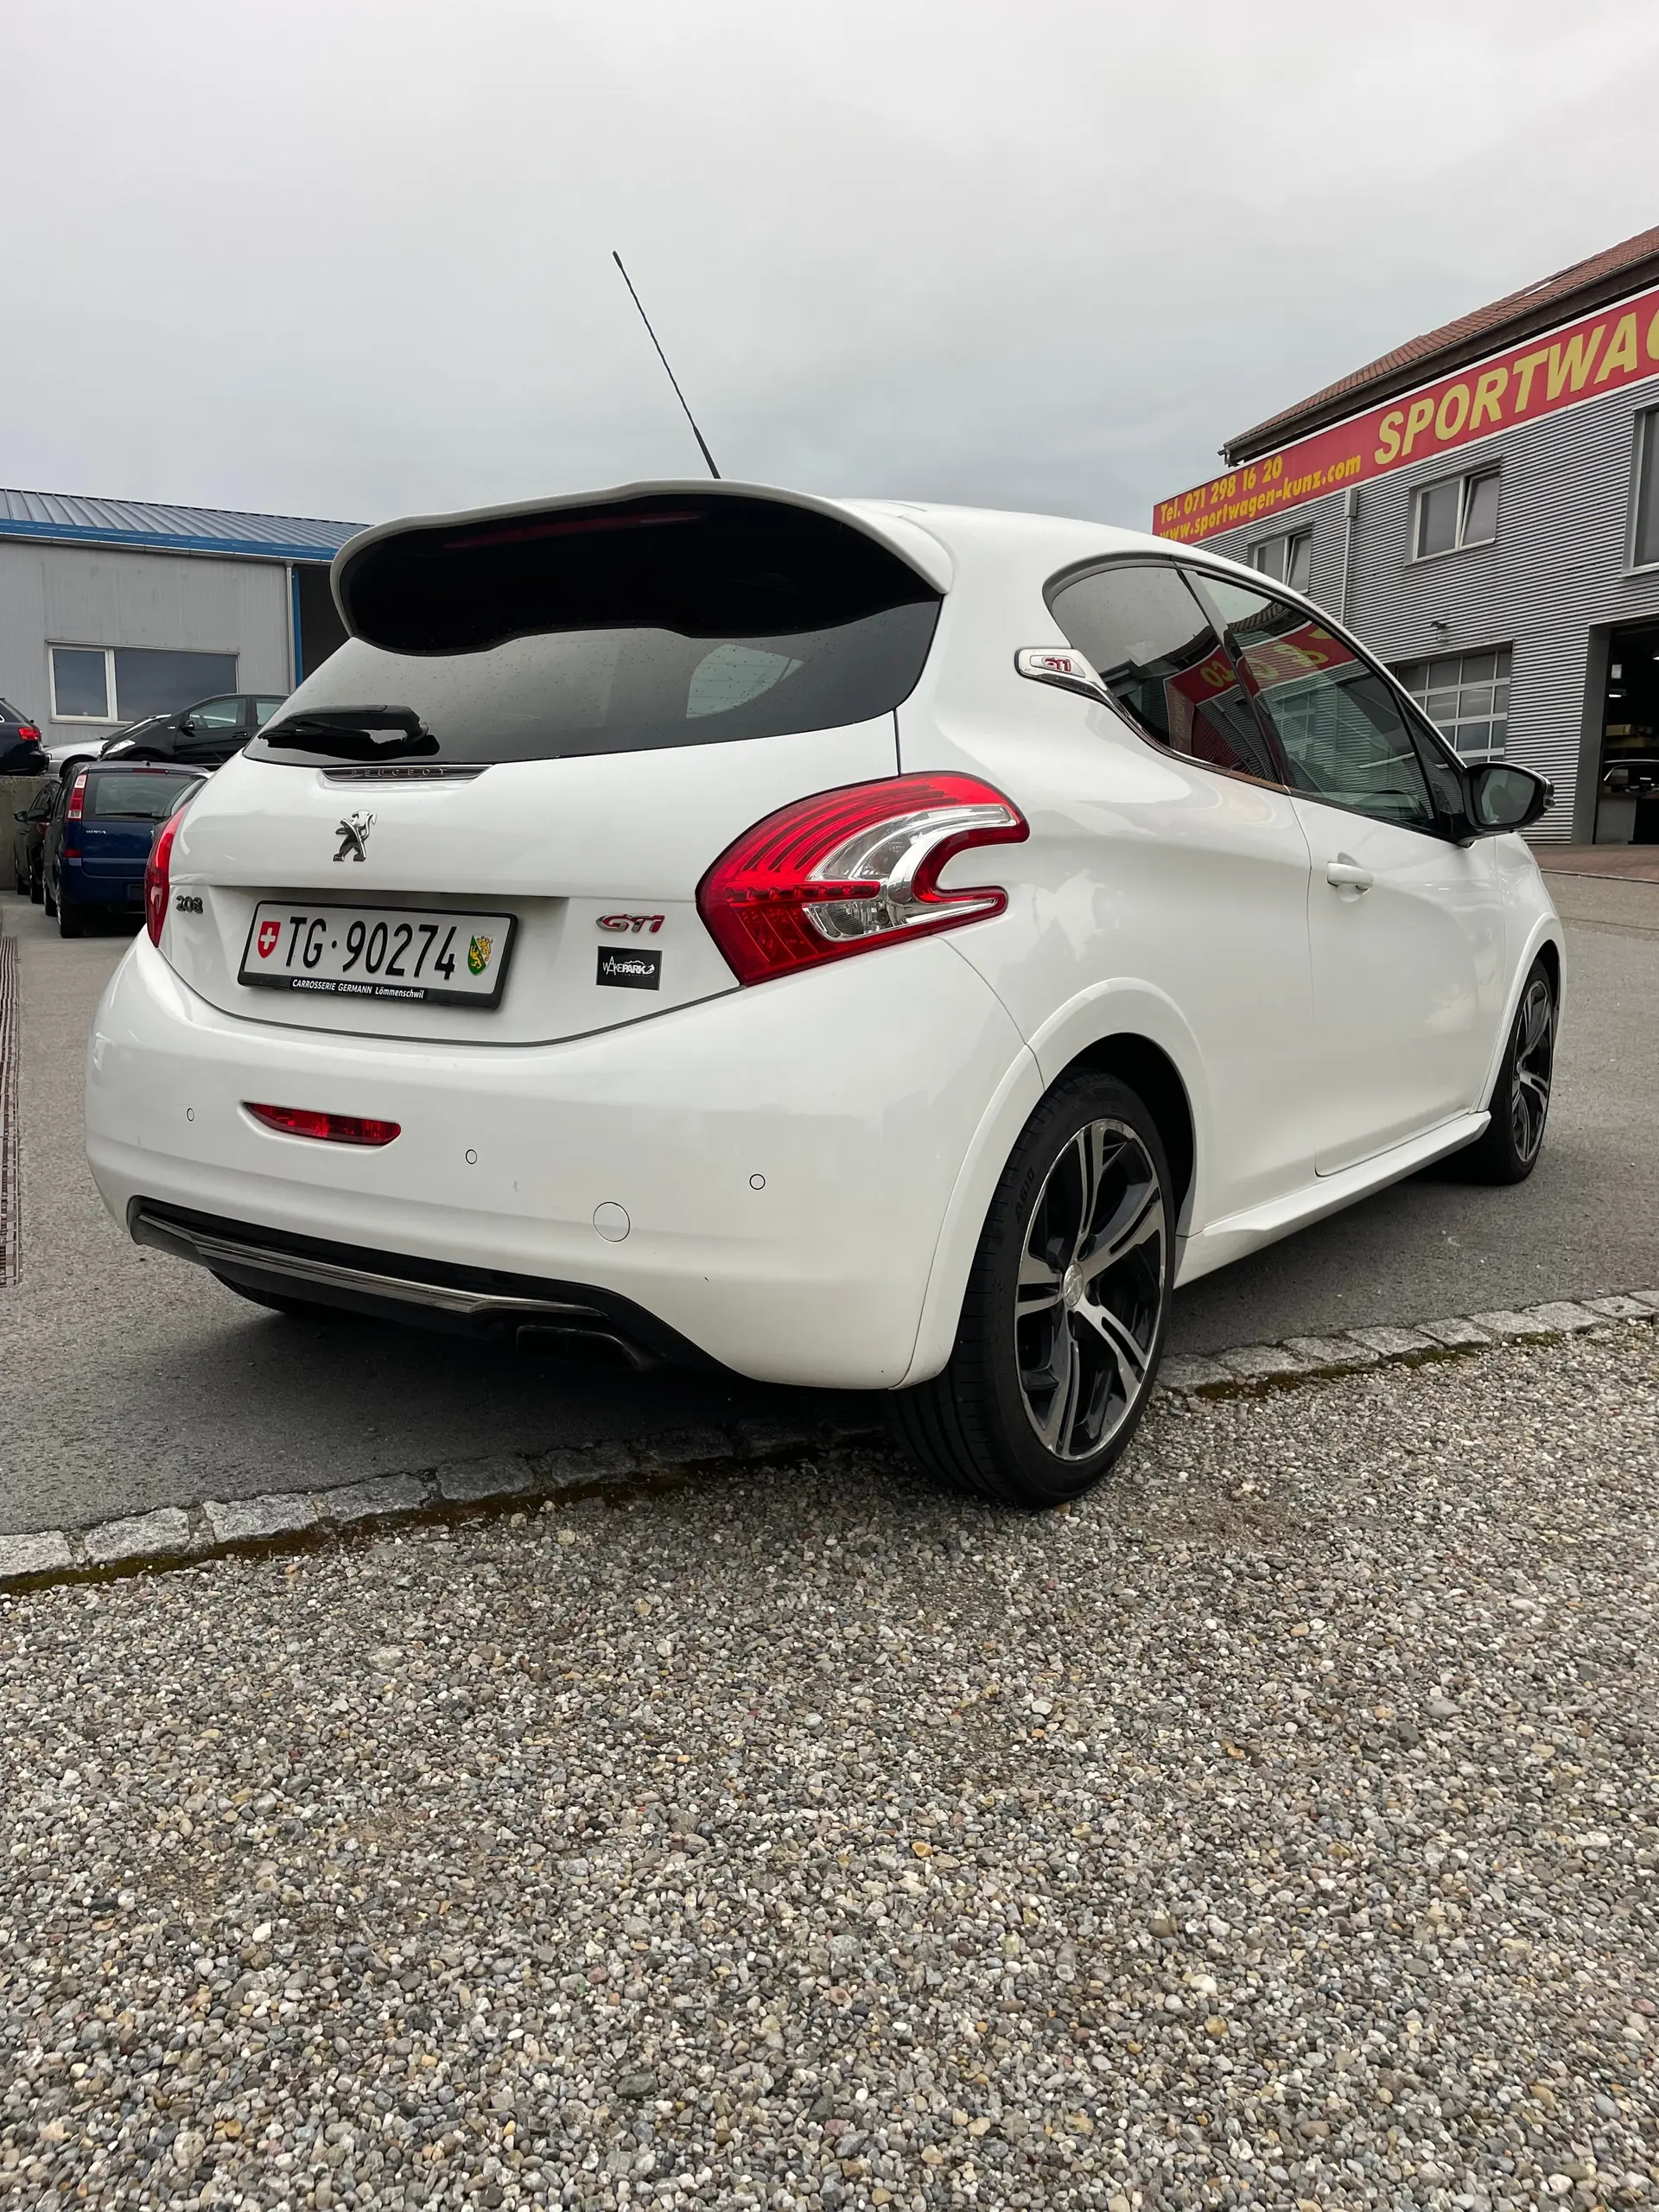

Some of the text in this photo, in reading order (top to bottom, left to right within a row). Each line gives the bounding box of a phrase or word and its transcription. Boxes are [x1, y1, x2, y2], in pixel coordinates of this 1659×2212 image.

[1160, 455, 1283, 524] Tel. 071 298 16 20
[351, 767, 447, 776] PEUGEOT
[175, 895, 203, 914] 208
[292, 979, 425, 999] CARROSSERIE GERMANN Lömmenschwil
